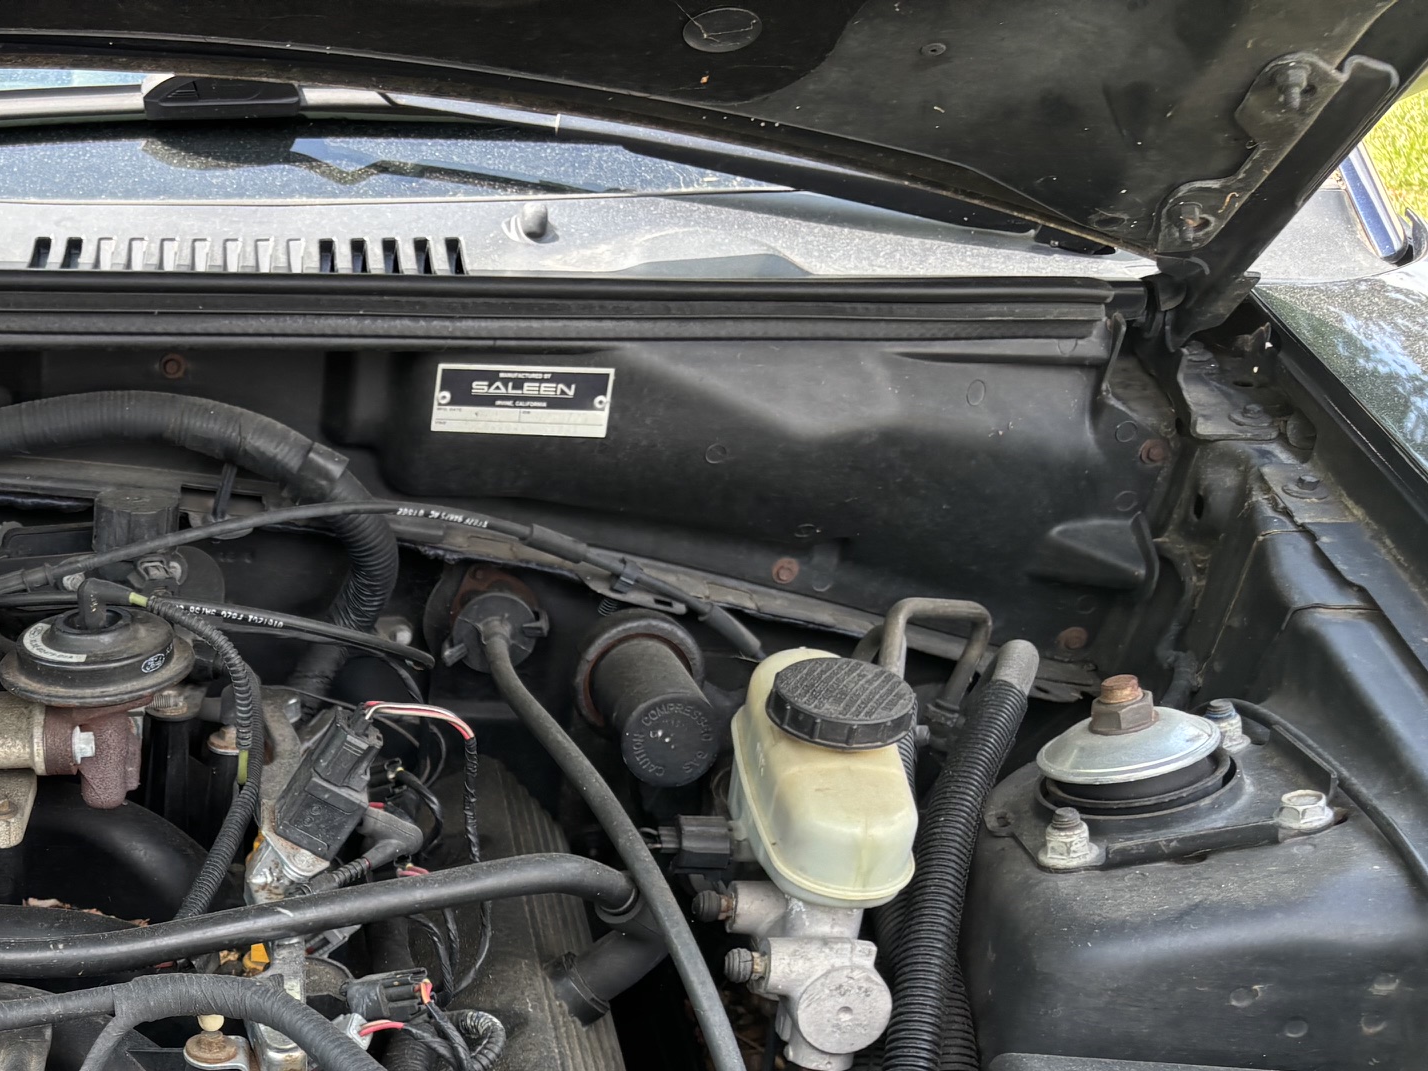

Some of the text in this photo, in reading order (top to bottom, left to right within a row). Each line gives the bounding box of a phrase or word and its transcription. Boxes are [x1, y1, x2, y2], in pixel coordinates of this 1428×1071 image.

[471, 381, 577, 397] SALEEN
[632, 733, 665, 777] CAUTION
[682, 750, 709, 774] GAS
